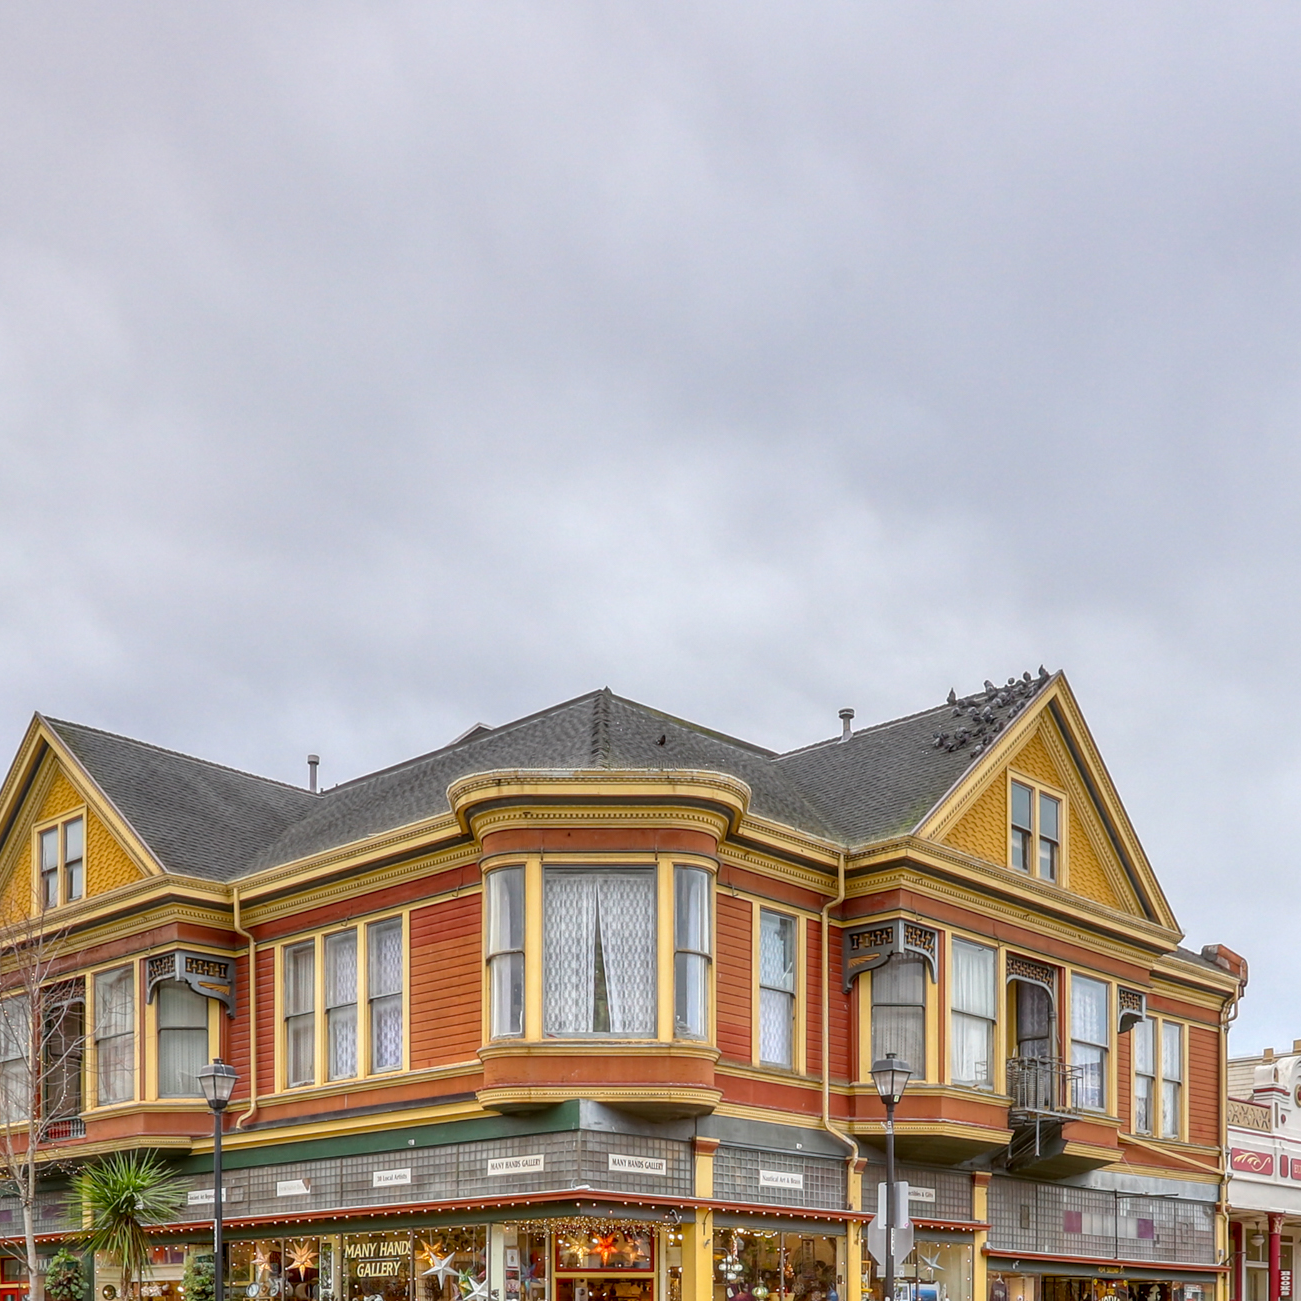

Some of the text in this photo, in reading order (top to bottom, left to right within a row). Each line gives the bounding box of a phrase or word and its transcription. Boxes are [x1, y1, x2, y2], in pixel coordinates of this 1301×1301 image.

[490, 1158, 541, 1171] MANY HANDS GALLERY
[612, 1158, 664, 1170] MANY HANDS GALLERY
[383, 1174, 394, 1182] Local
[344, 1241, 411, 1258] MANY HANDS
[357, 1261, 401, 1277] GALLERY
[1280, 1270, 1292, 1296] BOOKS
